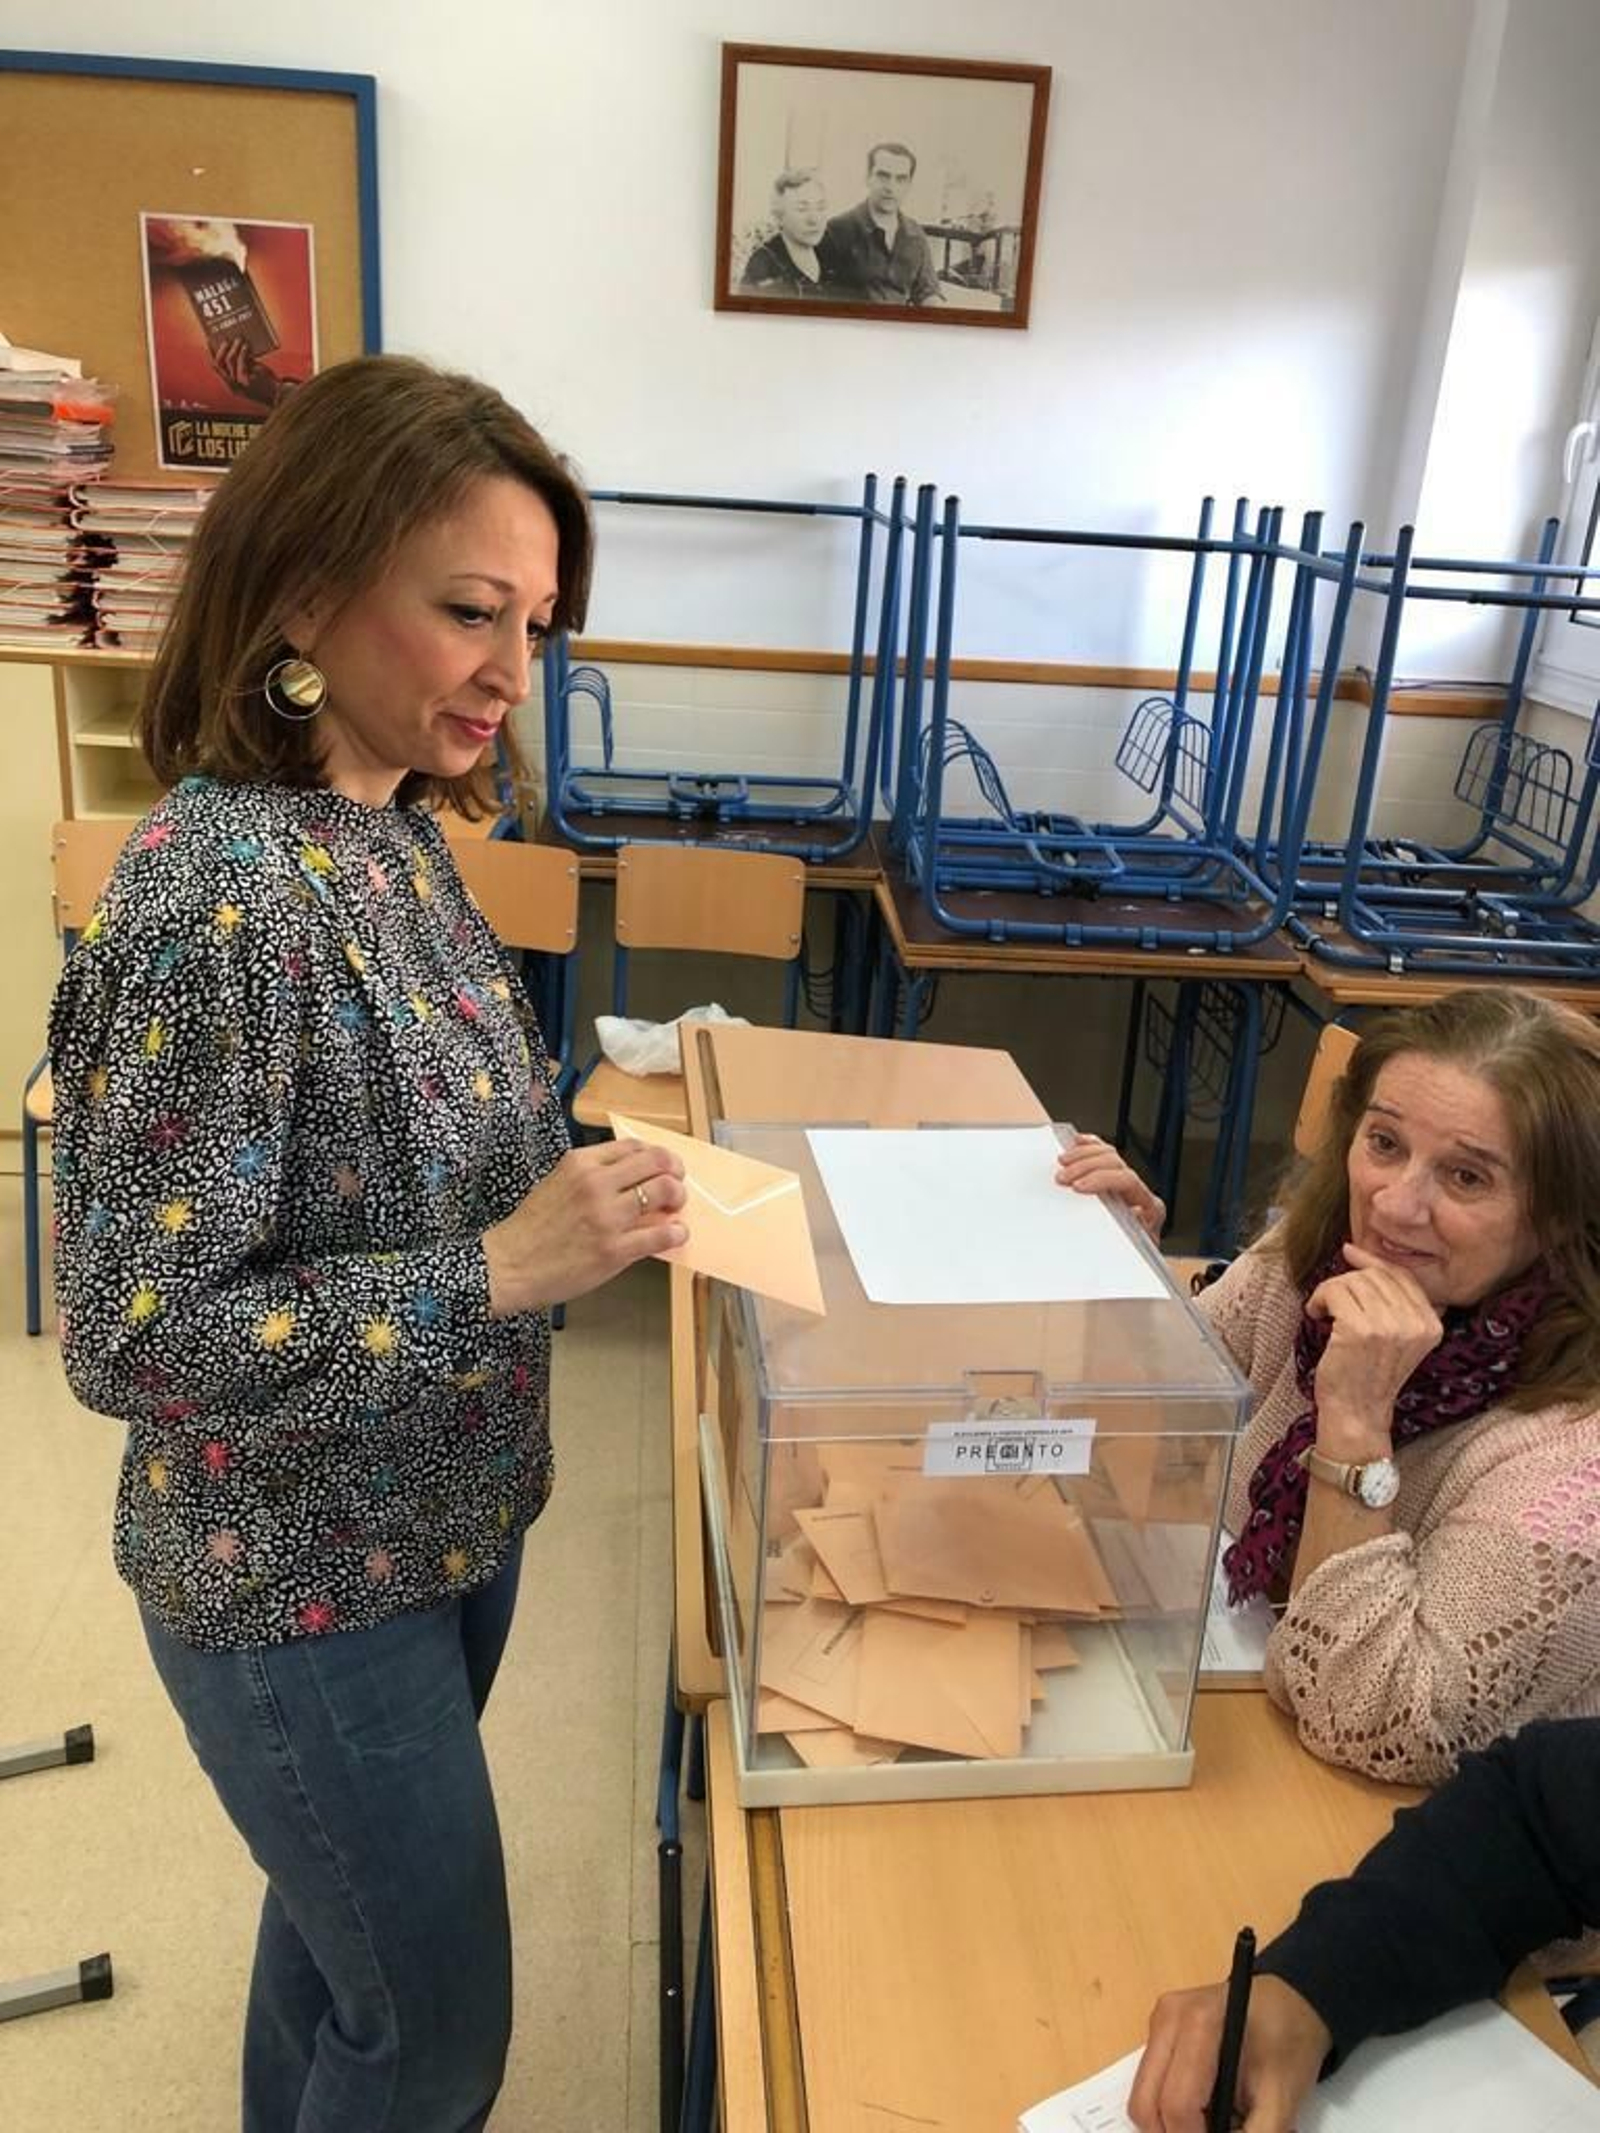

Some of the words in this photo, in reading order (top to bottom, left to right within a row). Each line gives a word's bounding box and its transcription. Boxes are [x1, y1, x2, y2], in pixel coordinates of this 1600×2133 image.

[203, 295, 231, 317] 451
[196, 421, 209, 437] LA
[197, 438, 225, 458] LOS
